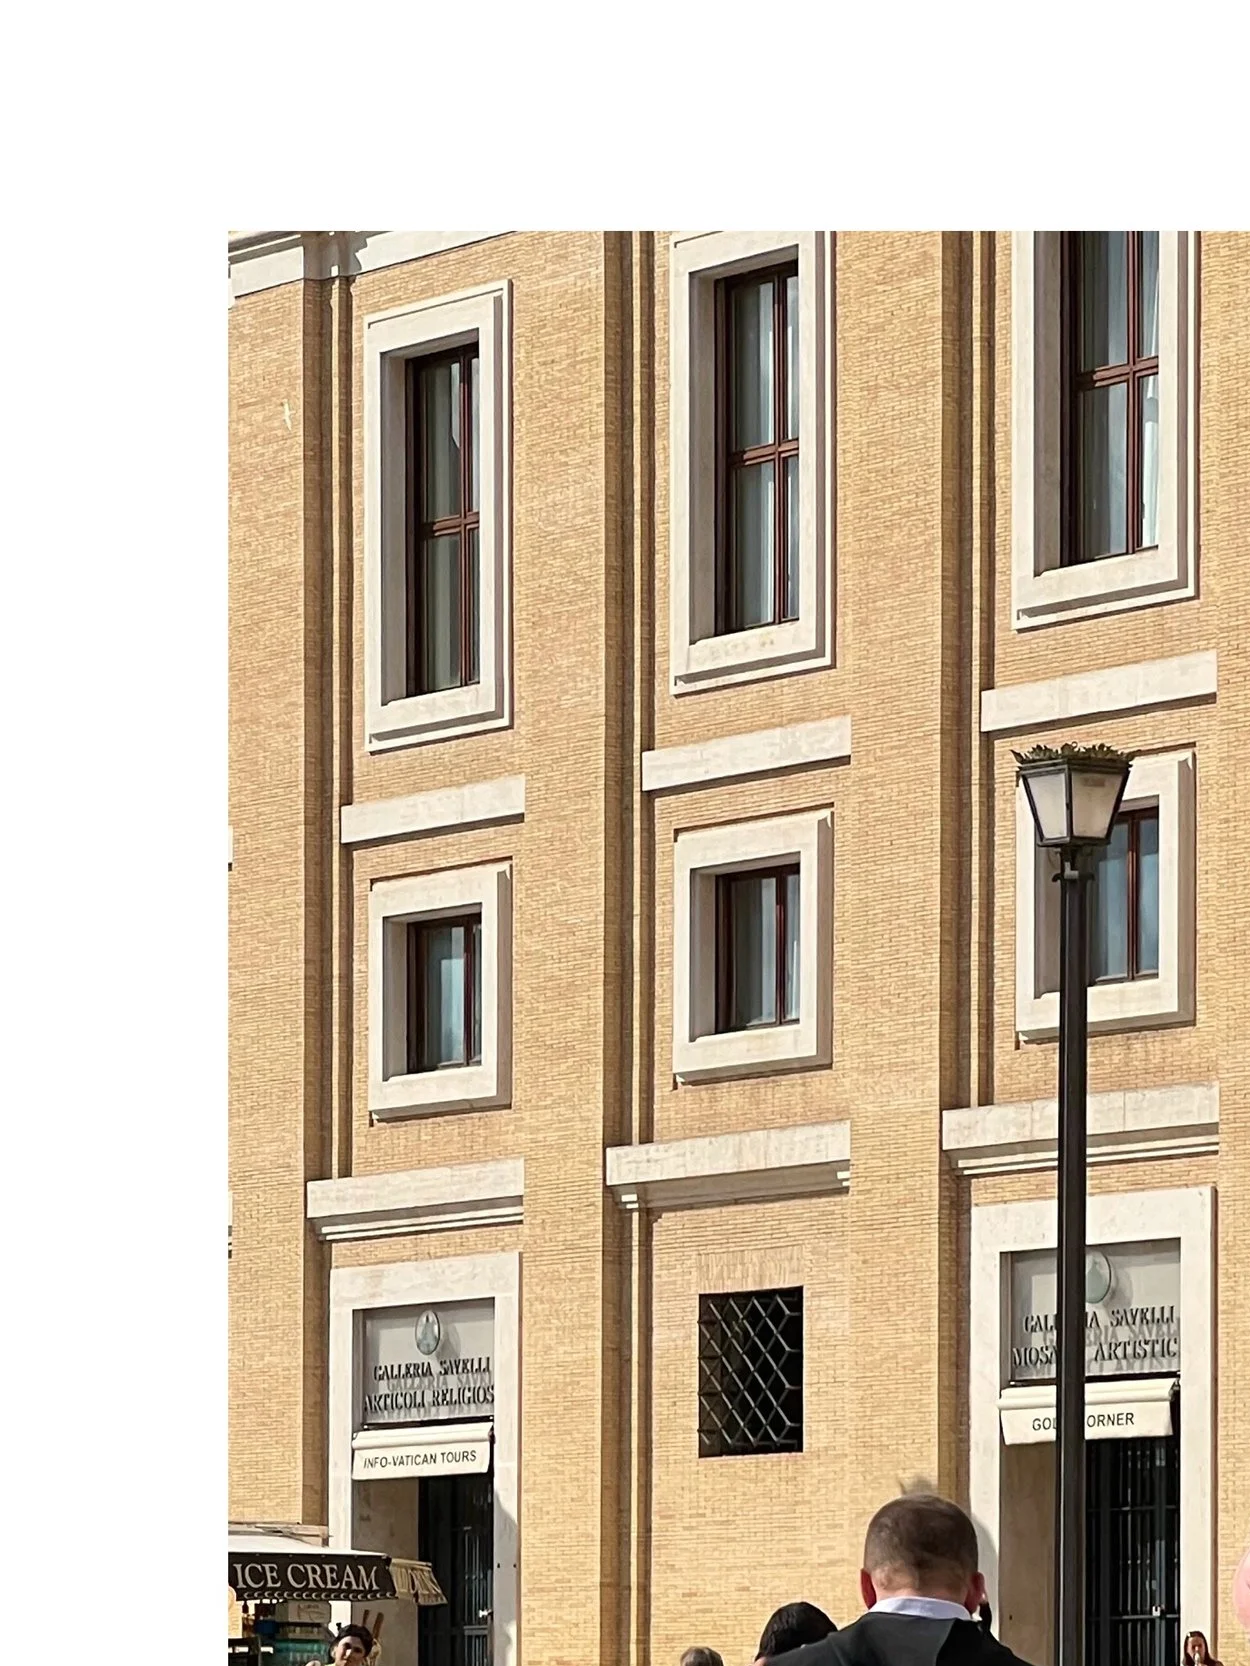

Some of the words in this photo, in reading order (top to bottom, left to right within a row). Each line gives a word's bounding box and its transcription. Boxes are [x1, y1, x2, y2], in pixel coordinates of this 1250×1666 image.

[374, 1361, 433, 1381] GALLERIA
[439, 1356, 490, 1377] SAVELLI
[364, 1390, 425, 1414] ARTICOLI
[1086, 1412, 1135, 1428] ORNER
[363, 1452, 437, 1469] INFO-VATICAN
[440, 1449, 477, 1464] TOURS
[233, 1563, 282, 1589] ICE
[286, 1563, 380, 1591] CREAM
